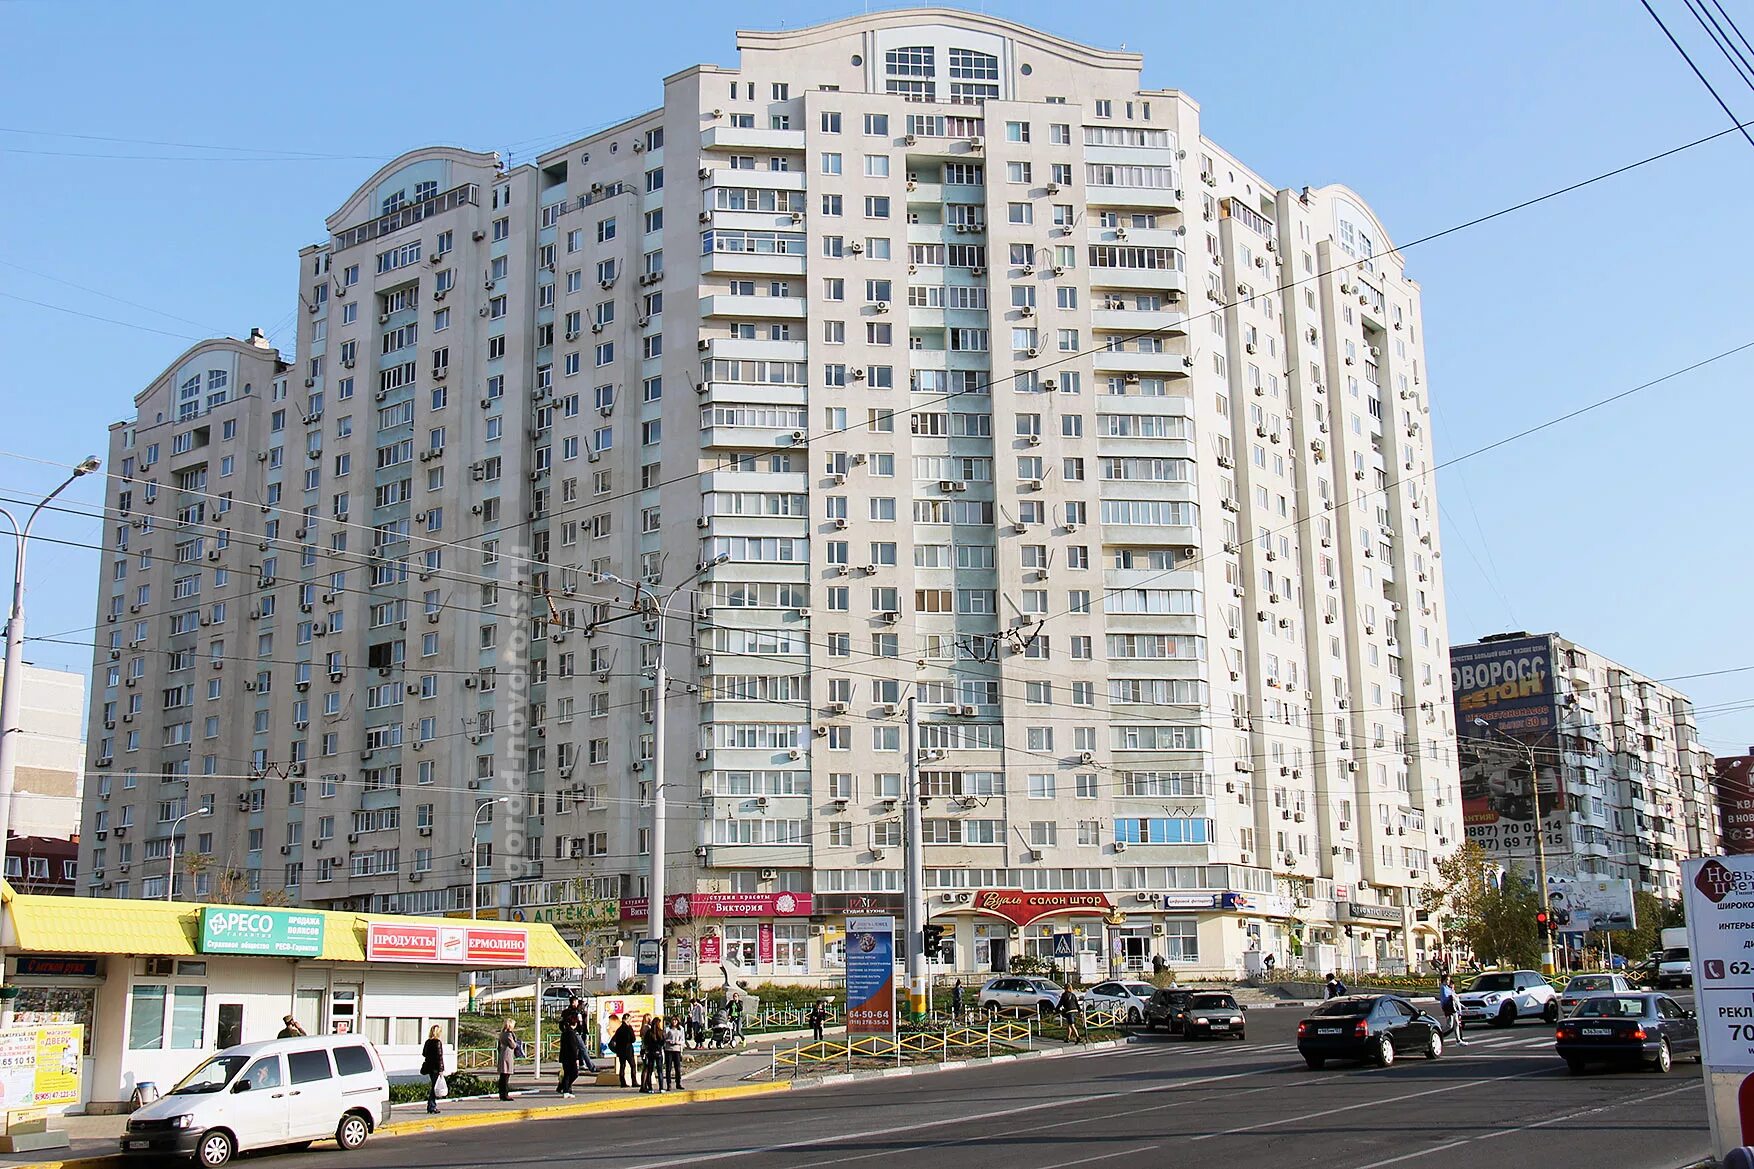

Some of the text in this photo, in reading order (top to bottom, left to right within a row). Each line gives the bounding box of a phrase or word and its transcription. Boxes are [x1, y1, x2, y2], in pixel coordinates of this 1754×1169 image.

[1502, 823, 1519, 835] 70
[1545, 820, 1562, 831] 14
[1504, 836, 1520, 848] 69
[1546, 833, 1563, 845] 15
[983, 891, 1102, 910] Вуаль салон штор
[534, 903, 596, 923] АПТЕКА
[715, 903, 763, 914] Виктория
[227, 912, 274, 933] РЕСО
[288, 916, 320, 926] ПРОДАЖА
[287, 926, 319, 935] ПОЛИСОВ
[207, 940, 239, 949] Страховое
[241, 941, 270, 950] общество
[373, 934, 436, 947] ПРОДУКТЫ
[469, 938, 525, 950] ЕРМОЛИНО
